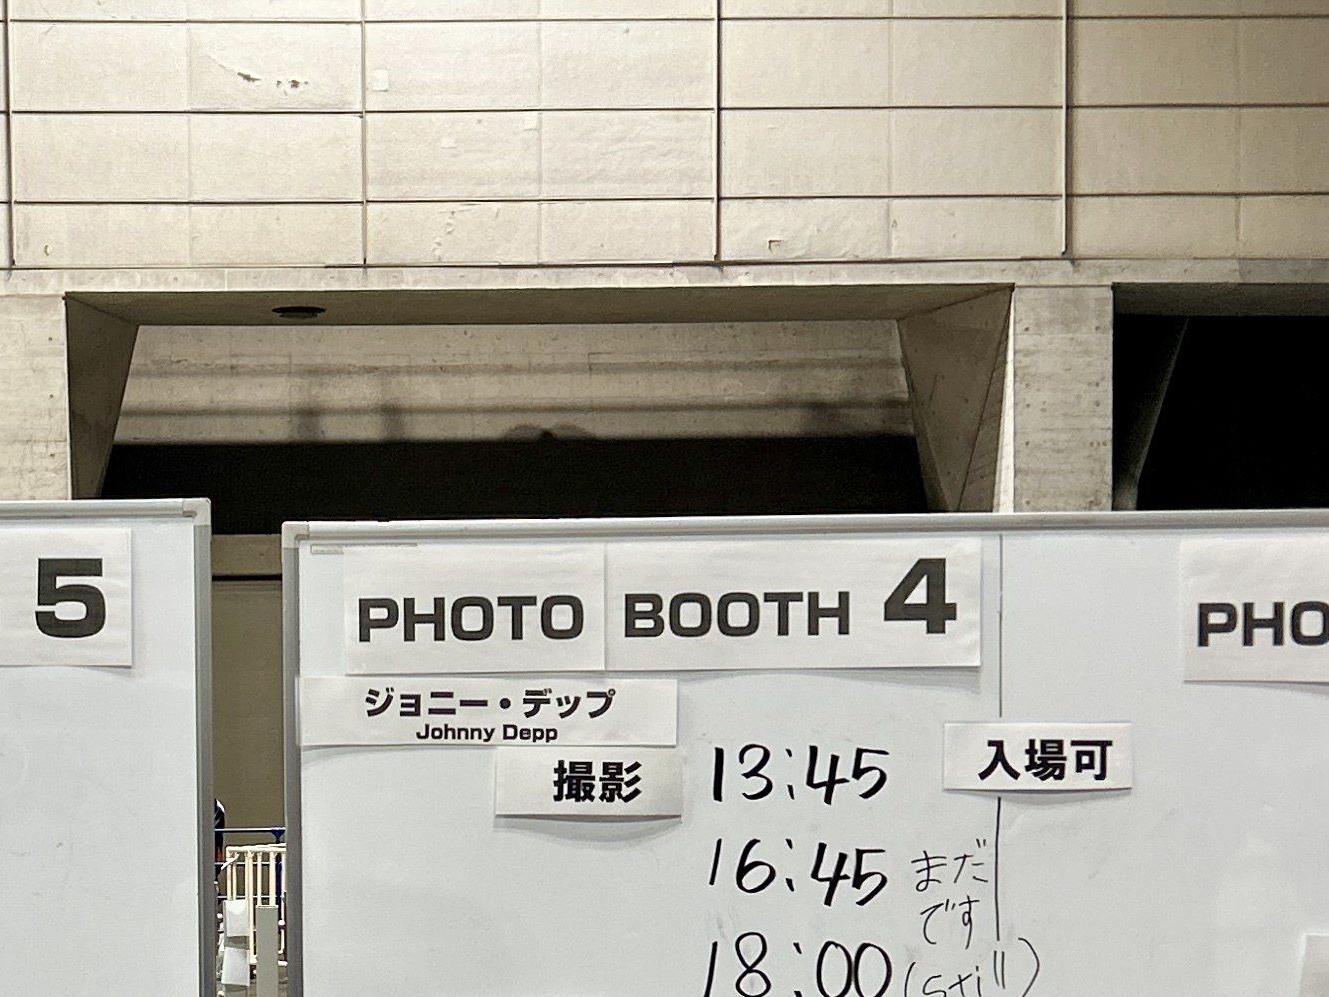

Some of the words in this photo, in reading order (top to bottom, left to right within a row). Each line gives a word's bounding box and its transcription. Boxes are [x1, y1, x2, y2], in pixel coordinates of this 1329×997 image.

[35, 558, 105, 638] 5
[359, 595, 583, 642] PHOTO
[625, 592, 849, 637] BOOTH
[884, 558, 956, 634] 4
[366, 688, 615, 718] ジョニー・デップ
[416, 724, 495, 745] Johnny
[503, 725, 557, 743] Depp
[978, 739, 1112, 781] 入場可
[553, 760, 642, 803] 撮影
[713, 744, 889, 805] 13:45
[709, 839, 887, 906] 16:45
[911, 839, 988, 892] まだ
[920, 895, 980, 949] です
